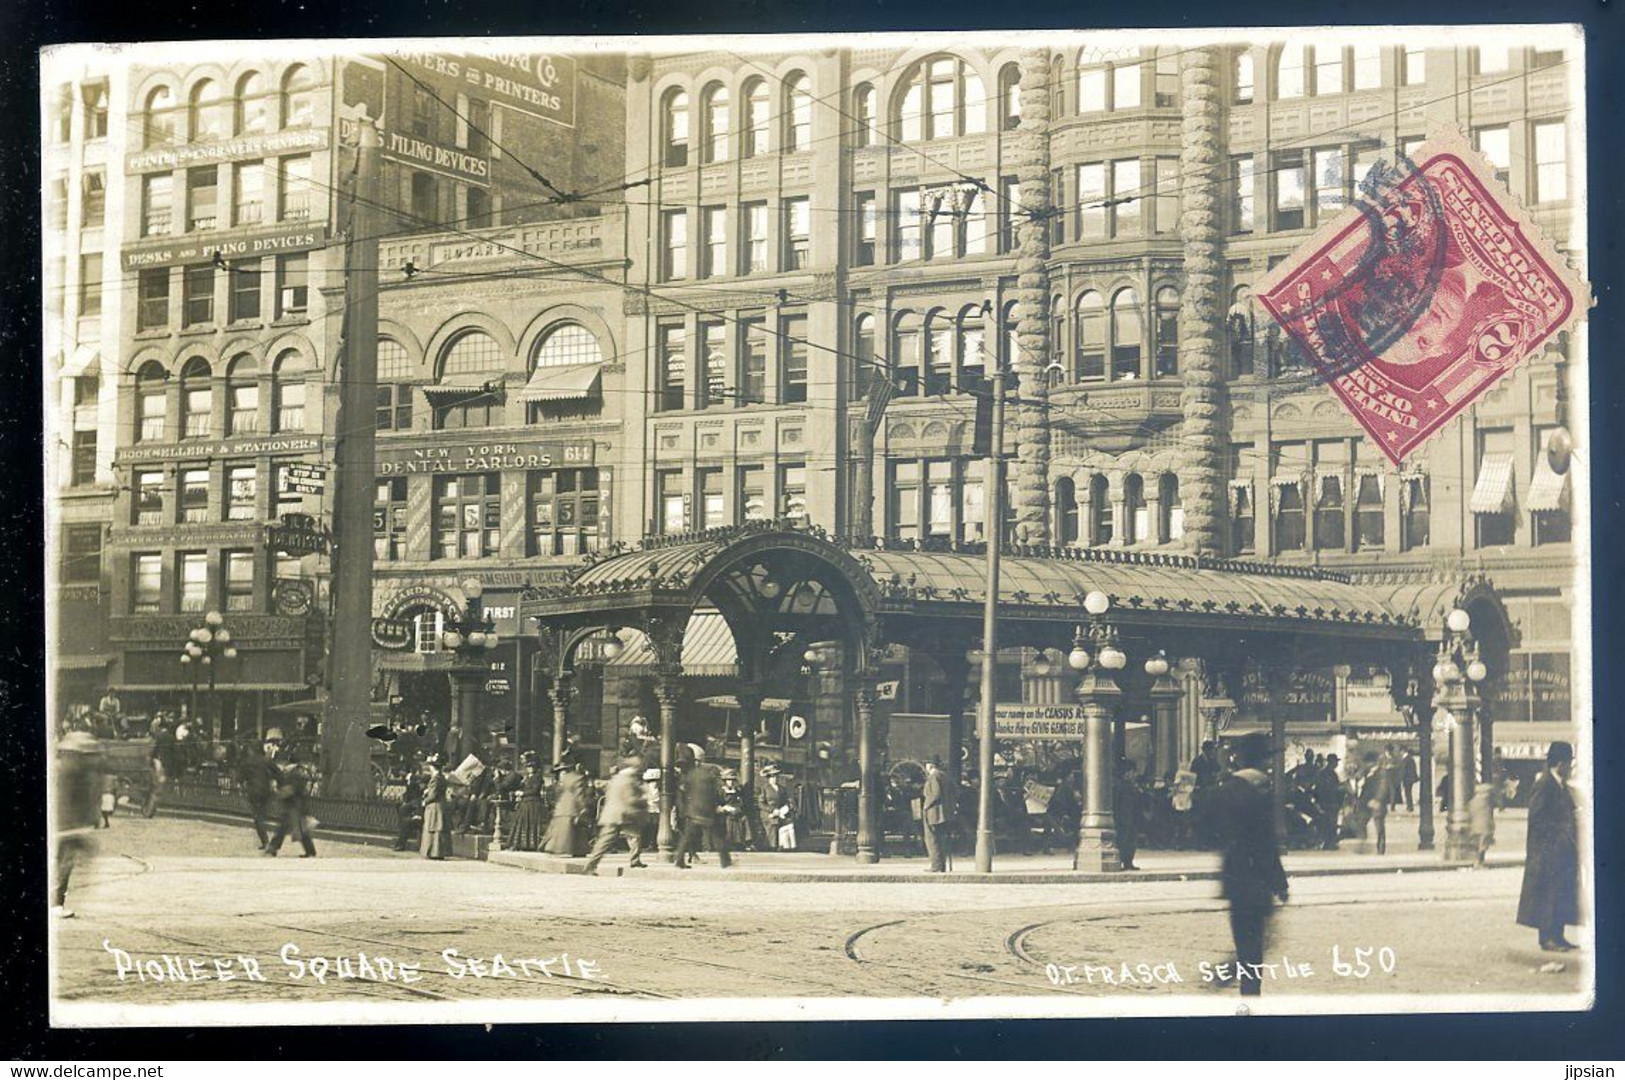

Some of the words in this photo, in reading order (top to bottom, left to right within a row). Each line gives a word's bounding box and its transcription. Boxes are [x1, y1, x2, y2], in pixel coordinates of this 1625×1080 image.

[537, 55, 559, 87] Co.
[484, 73, 561, 111] PRINTERS
[434, 147, 487, 177] DEVICES
[1441, 169, 1513, 254] CENTS
[129, 251, 172, 265] DESKS
[180, 249, 196, 258] AND
[203, 241, 247, 257] FILING
[254, 233, 315, 250] DEVICES
[1445, 192, 1539, 302] POSTAGE
[1453, 223, 1508, 288] WASHINGTON
[1509, 253, 1558, 312] TWO
[1478, 322, 1517, 361] 2
[118, 445, 215, 460] BOOKSELLERS
[219, 446, 229, 454] &
[233, 439, 319, 454] STATIONERS
[381, 459, 457, 475] DENTAL
[465, 454, 552, 470] PARLORS
[414, 447, 450, 459] NEW
[467, 443, 517, 456] YORK
[564, 445, 589, 462] 614
[374, 512, 384, 528] 5
[560, 505, 573, 523] 5
[600, 490, 610, 550] PAIN
[483, 607, 516, 619] FIRST
[1044, 707, 1073, 720] CENSUS
[103, 939, 267, 981] PIONEER
[280, 943, 423, 984] SQUARE
[1331, 944, 1396, 978] 650
